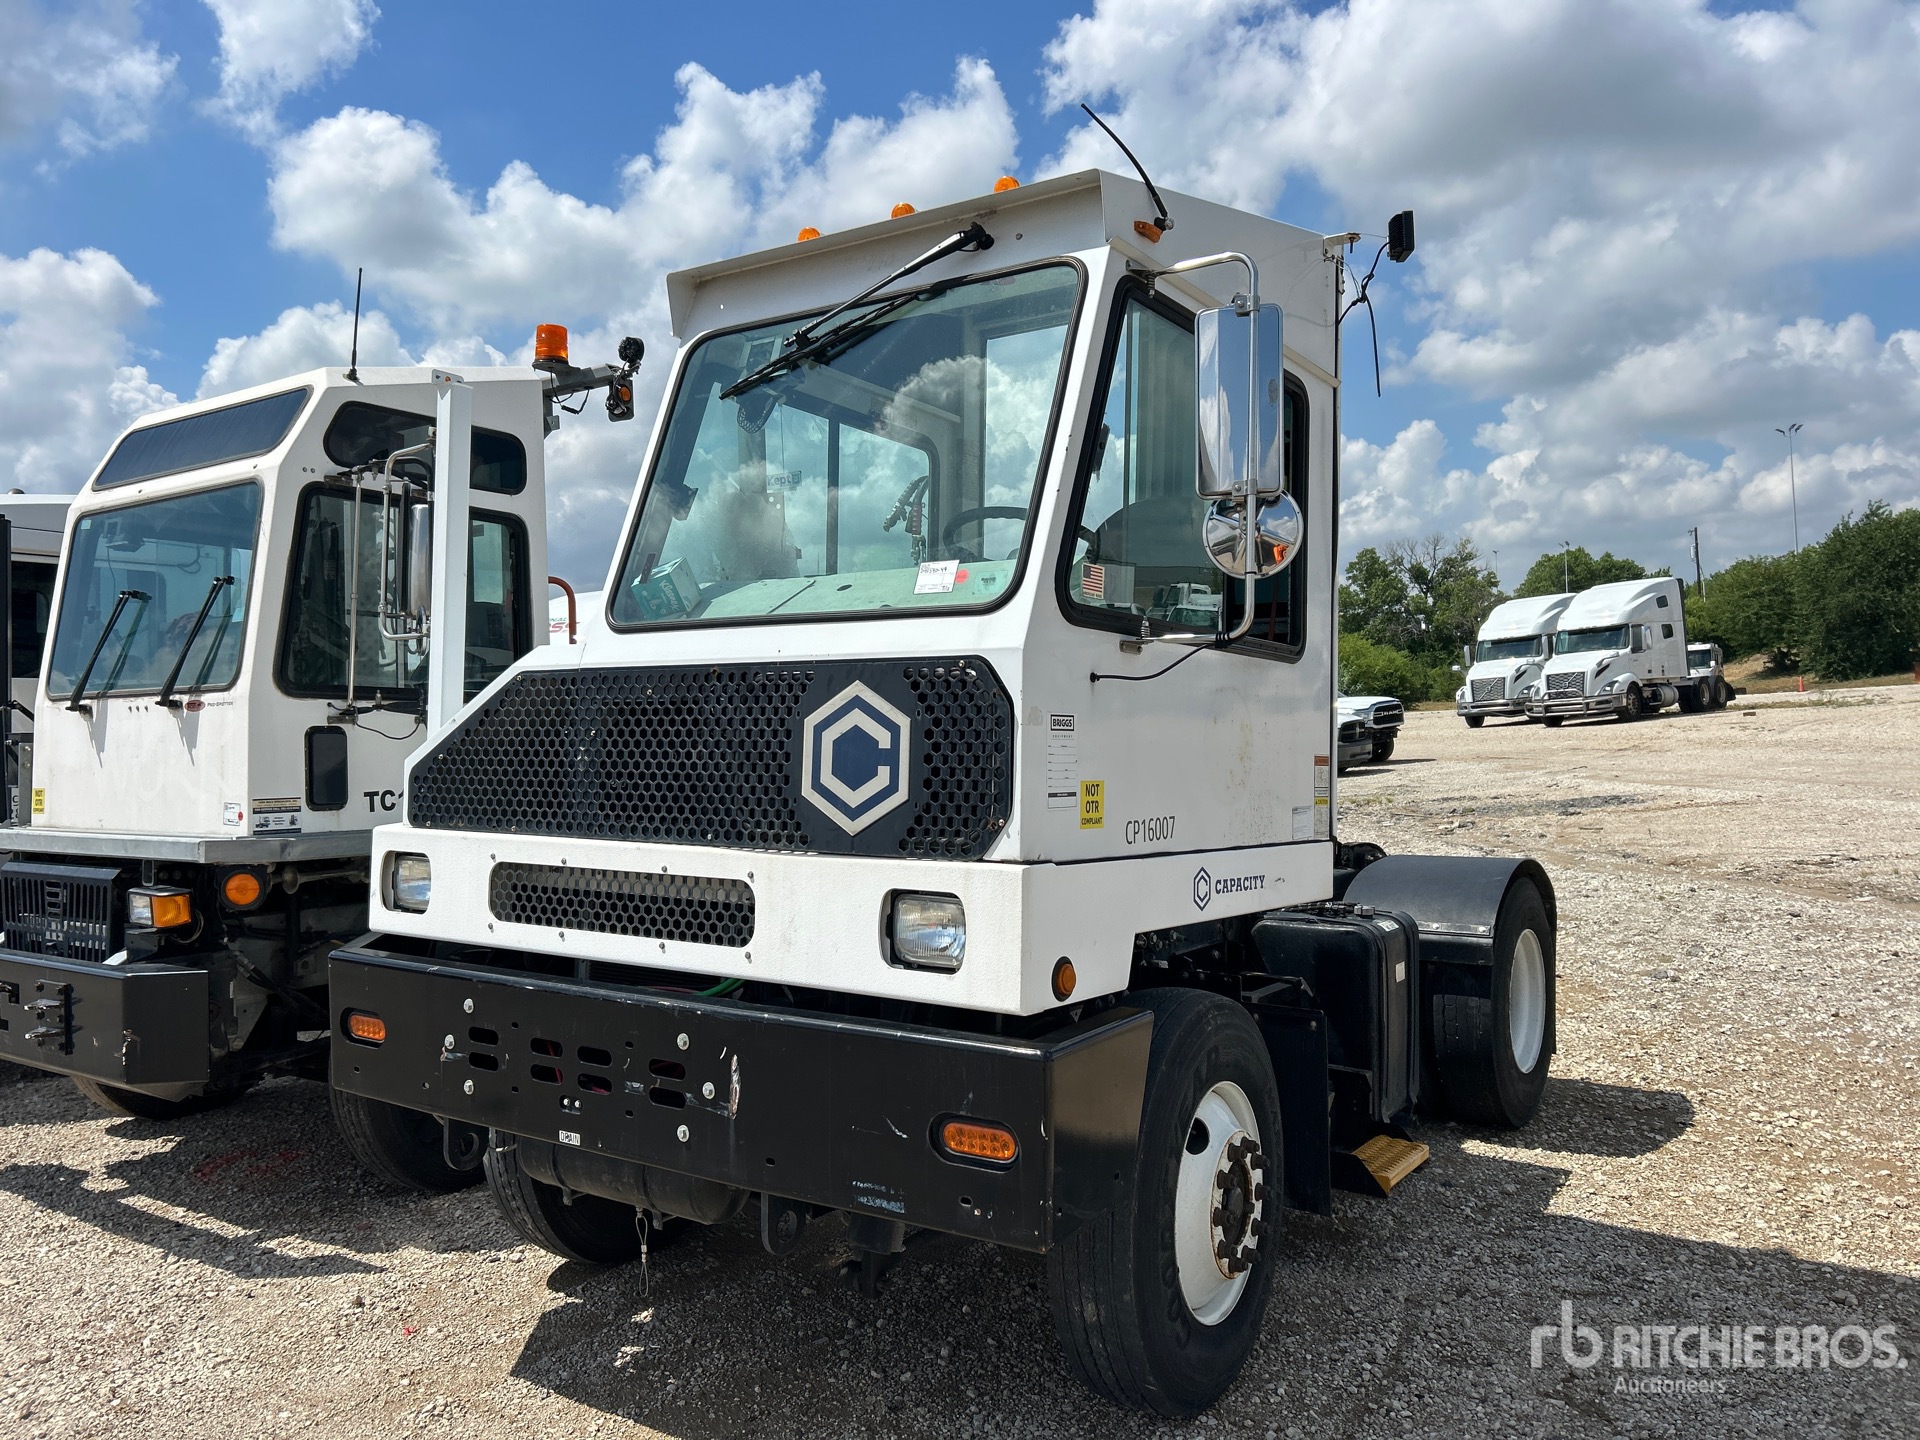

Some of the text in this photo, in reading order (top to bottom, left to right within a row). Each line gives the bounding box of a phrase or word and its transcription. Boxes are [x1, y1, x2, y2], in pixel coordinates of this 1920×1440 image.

[659, 580, 680, 611] Kleenex
[1052, 718, 1073, 728] BRIGGS
[1085, 783, 1100, 797] NOT
[1085, 800, 1100, 813] OTR
[1081, 817, 1102, 825] COMPLIANT
[1125, 815, 1176, 845] CP16007
[1215, 875, 1265, 894] CAPACITY
[560, 1131, 580, 1144] DRAIN
